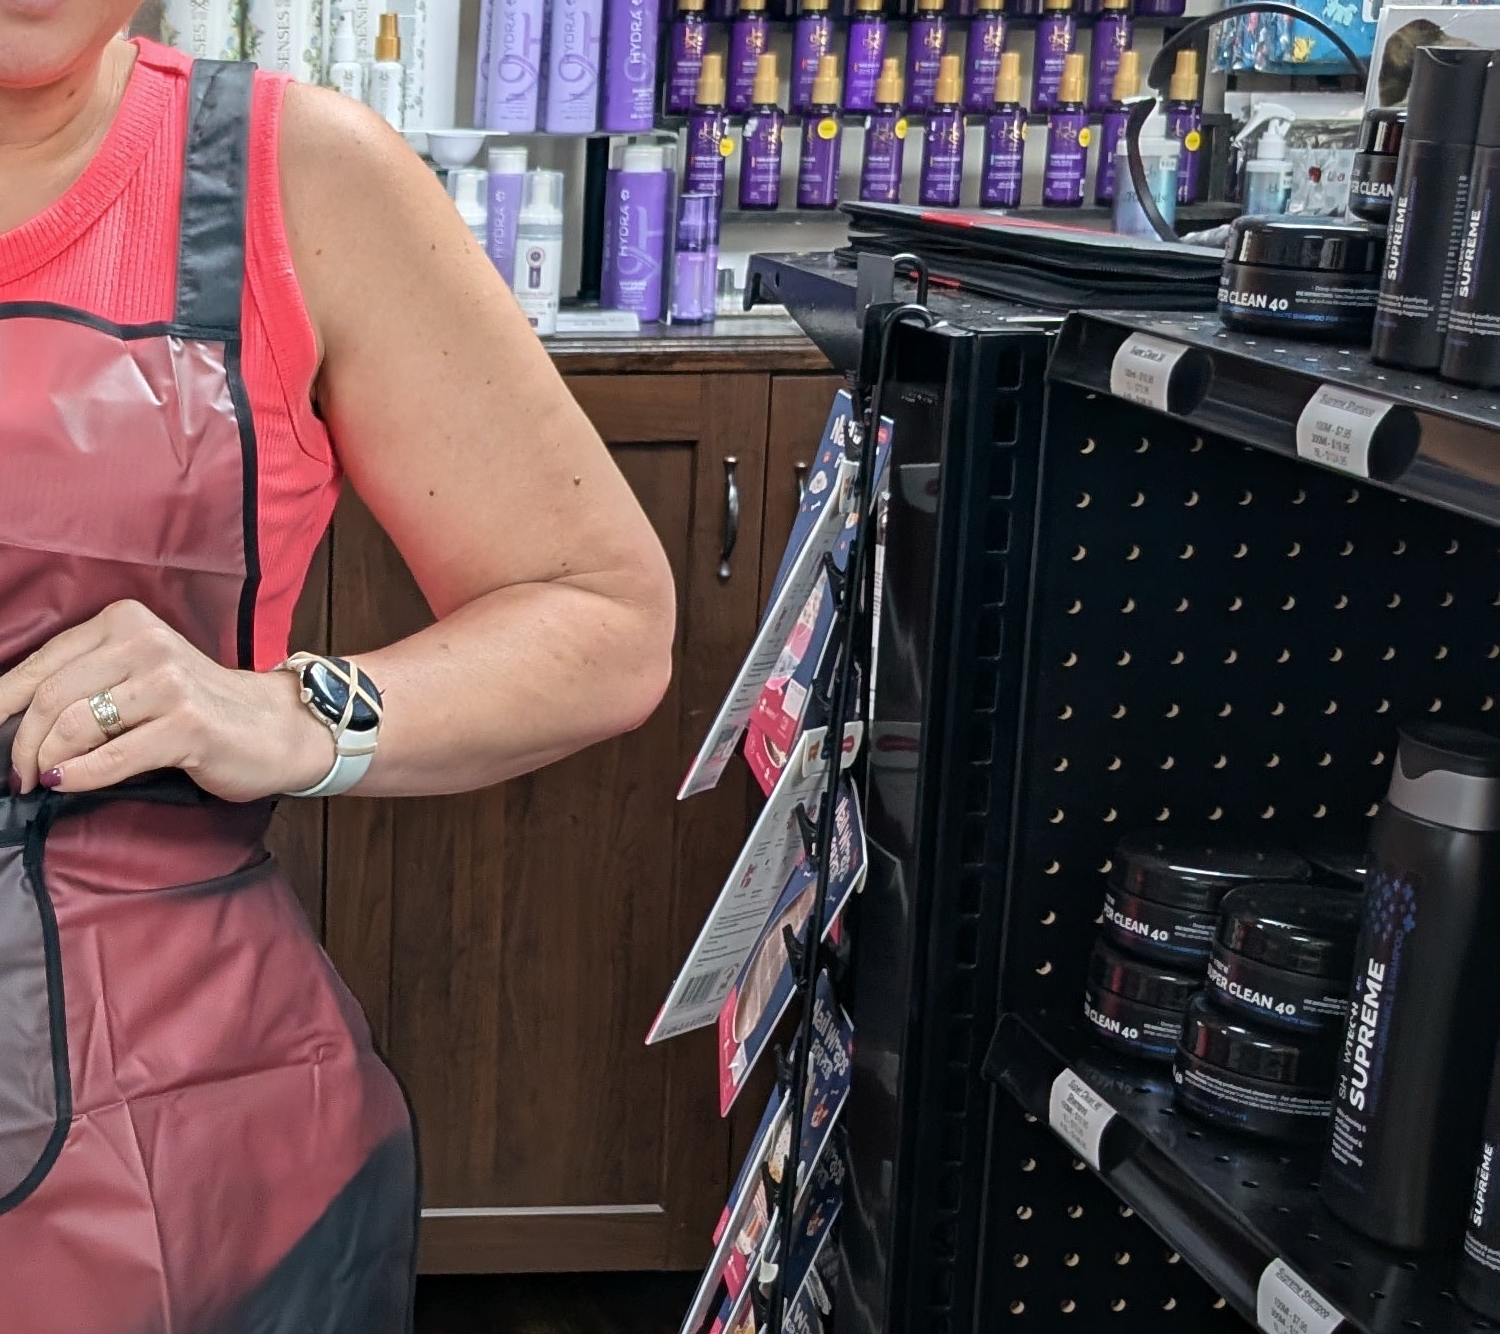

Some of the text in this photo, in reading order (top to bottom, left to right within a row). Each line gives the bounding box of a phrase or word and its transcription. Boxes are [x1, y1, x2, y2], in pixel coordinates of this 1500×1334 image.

[629, 10, 643, 64] HYDRA
[1360, 182, 1395, 198] CLEAN
[618, 205, 631, 257] HYDRA
[1388, 196, 1409, 281] SUPREME
[1459, 209, 1482, 298] SUPREME
[1229, 290, 1268, 310] CLEAN
[1268, 297, 1289, 312] 40
[1114, 911, 1169, 942] CLEAN 40
[1090, 1010, 1139, 1039] CLEAN 40
[1228, 981, 1274, 1011] CLEAN
[1274, 1001, 1296, 1016] 40
[1349, 957, 1387, 1112] SUPREME
[1471, 1142, 1493, 1227] SUPREME
[1274, 1267, 1331, 1320] Supreme Shampoo
